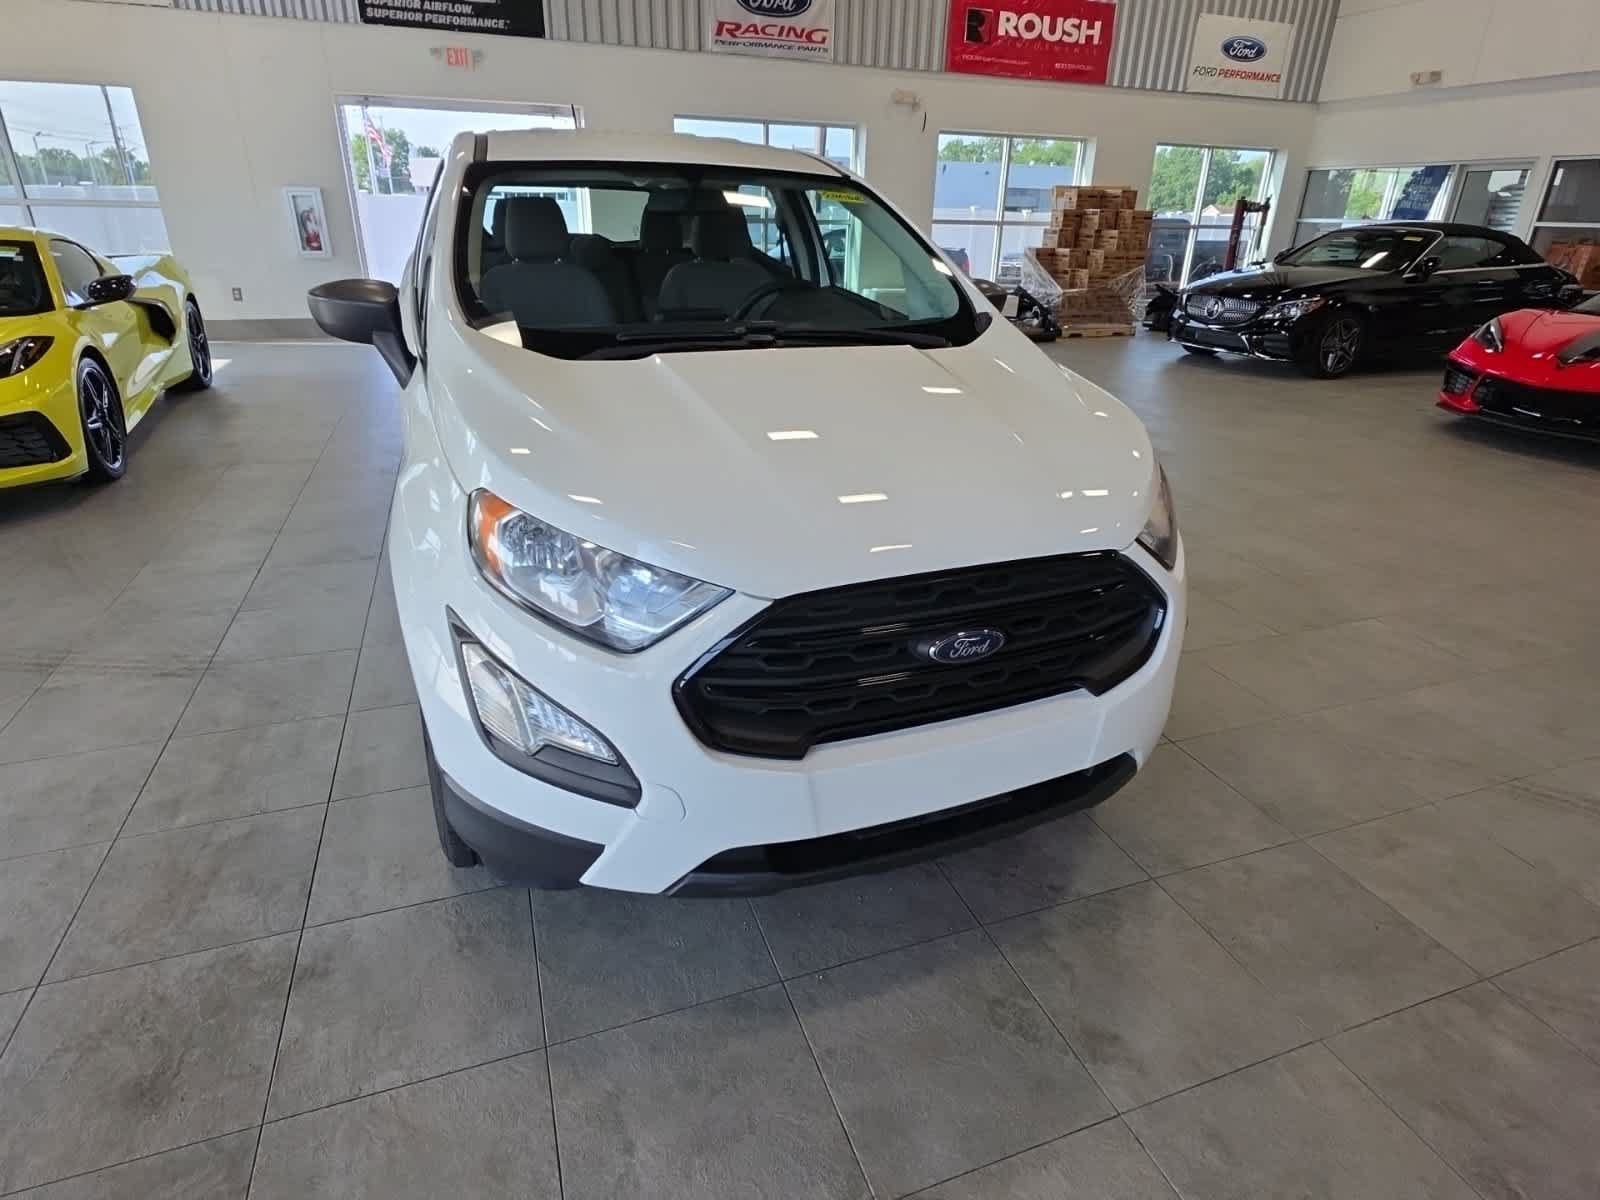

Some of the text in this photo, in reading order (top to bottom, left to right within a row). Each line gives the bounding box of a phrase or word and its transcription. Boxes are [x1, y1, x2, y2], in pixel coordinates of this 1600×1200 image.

[366, 8, 423, 21] SUPERIOR
[423, 1, 475, 15] AIRFLOW.
[749, 0, 796, 11] ord
[715, 20, 829, 44] RACING
[997, 10, 1102, 45] ROUSH
[714, 39, 828, 53] PERFORMANCE PARTS
[1229, 39, 1258, 57] Ford
[1193, 65, 1281, 83] FORD PERFORMANCE
[949, 637, 991, 658] Ford
